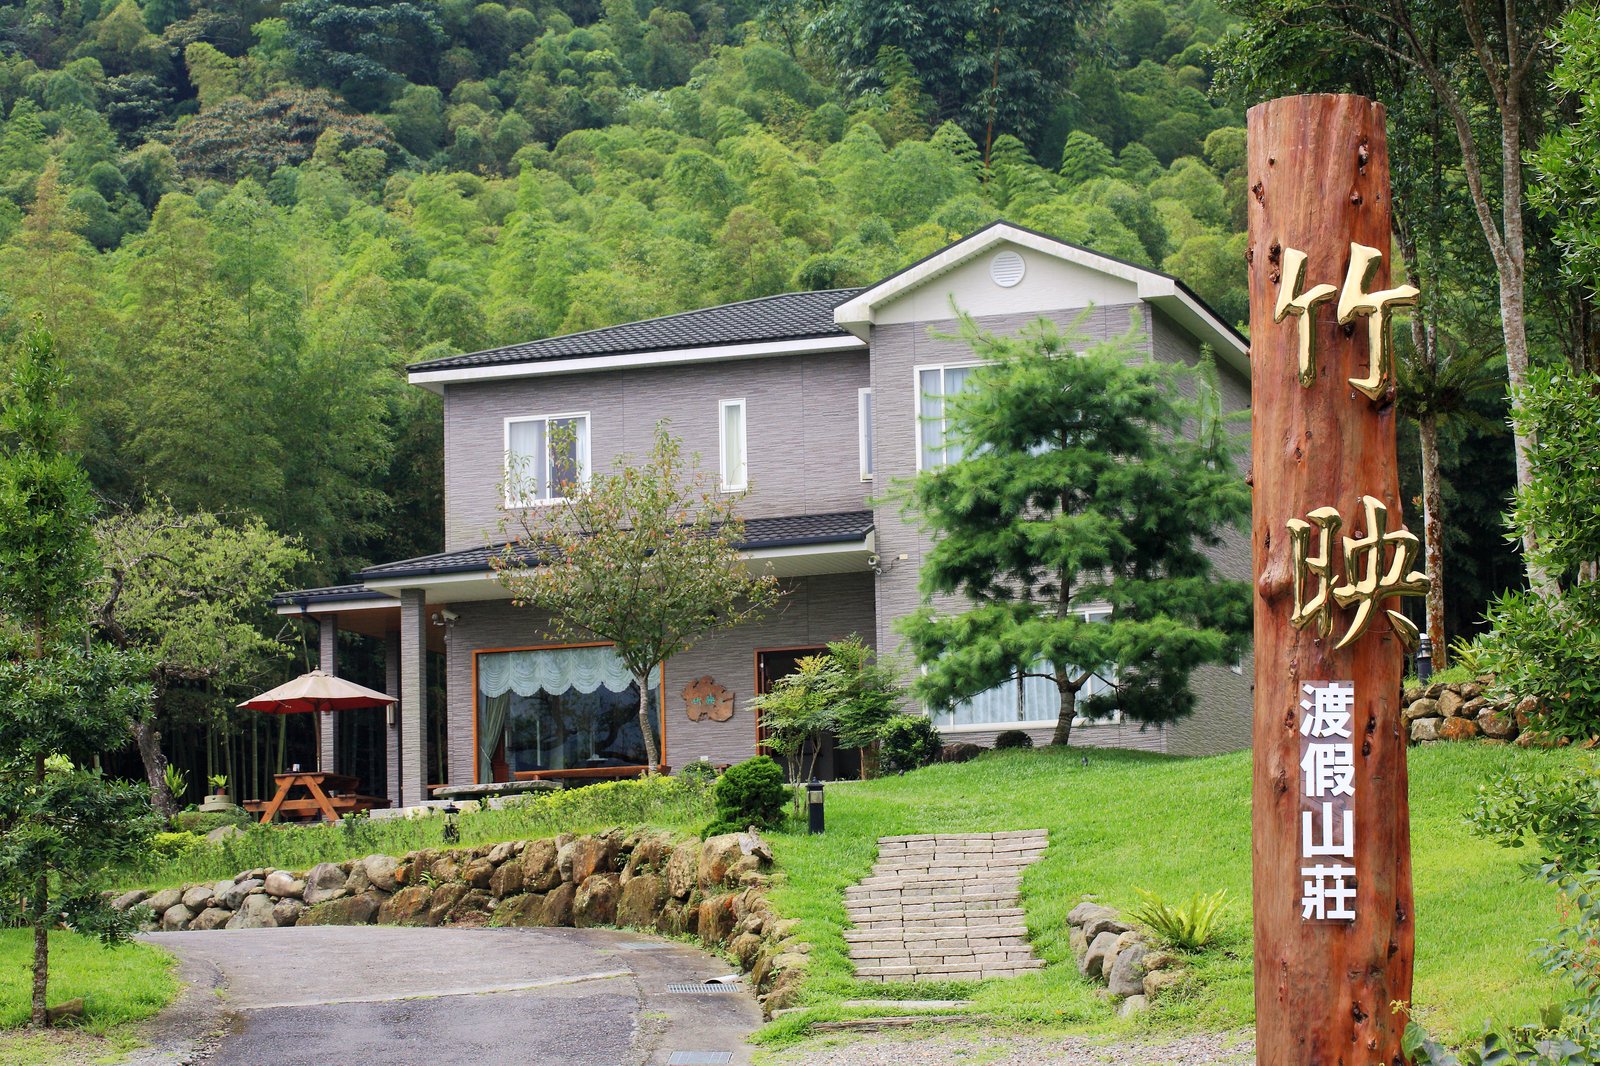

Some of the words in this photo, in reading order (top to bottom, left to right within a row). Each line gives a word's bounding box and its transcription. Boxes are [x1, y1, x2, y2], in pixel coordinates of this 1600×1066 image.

[1274, 242, 1432, 652] 竹映
[1300, 682, 1357, 921] 渡假山莊
